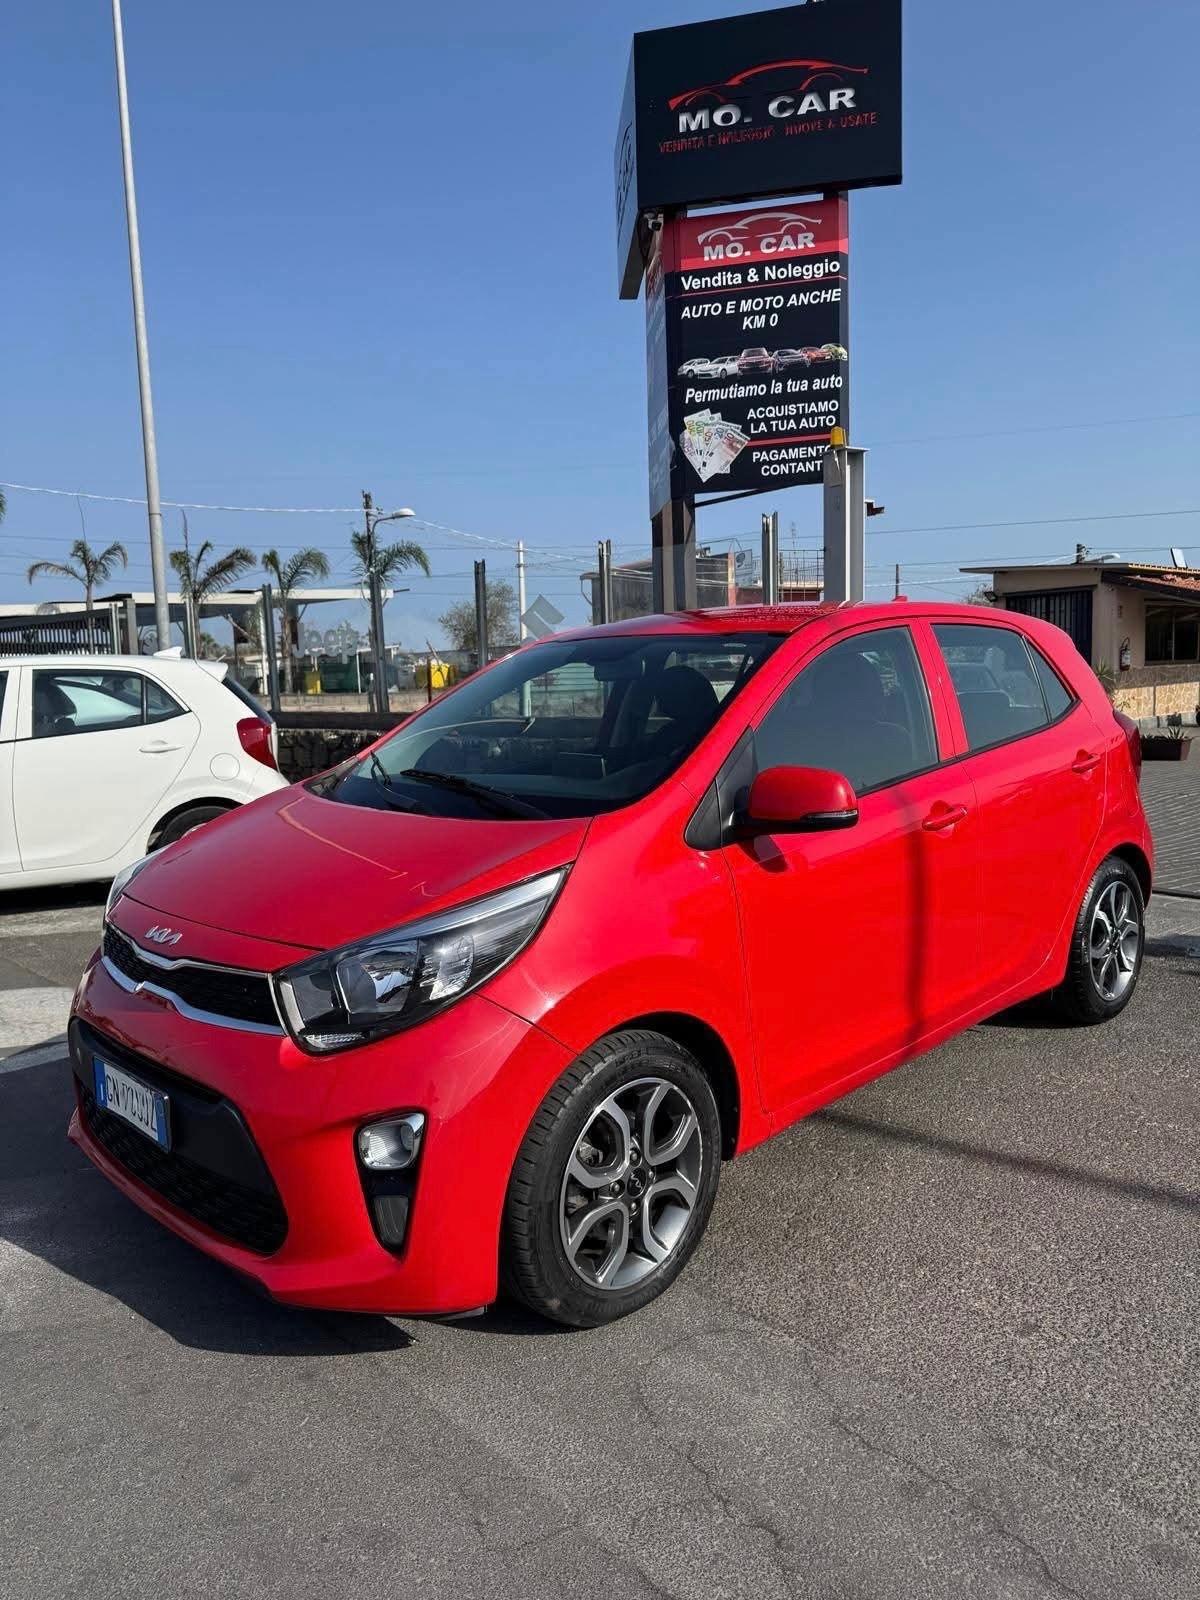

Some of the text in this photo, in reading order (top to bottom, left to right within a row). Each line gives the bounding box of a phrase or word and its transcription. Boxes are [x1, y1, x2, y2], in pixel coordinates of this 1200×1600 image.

[679, 87, 857, 133] MO. CAR
[840, 112, 879, 129] USATE
[703, 232, 816, 261] MO. CAR
[681, 258, 841, 291] Vendita & Noleggio
[681, 288, 841, 320] AUTO E MOTO ANCHE
[742, 315, 766, 330] KM
[685, 375, 843, 404] Permutiamo la tua auto
[747, 400, 839, 420] ACQUISTIAMO
[750, 415, 836, 434] LA TUA AUTO
[761, 460, 823, 476] CONTANT
[292, 623, 357, 665] Jeep
